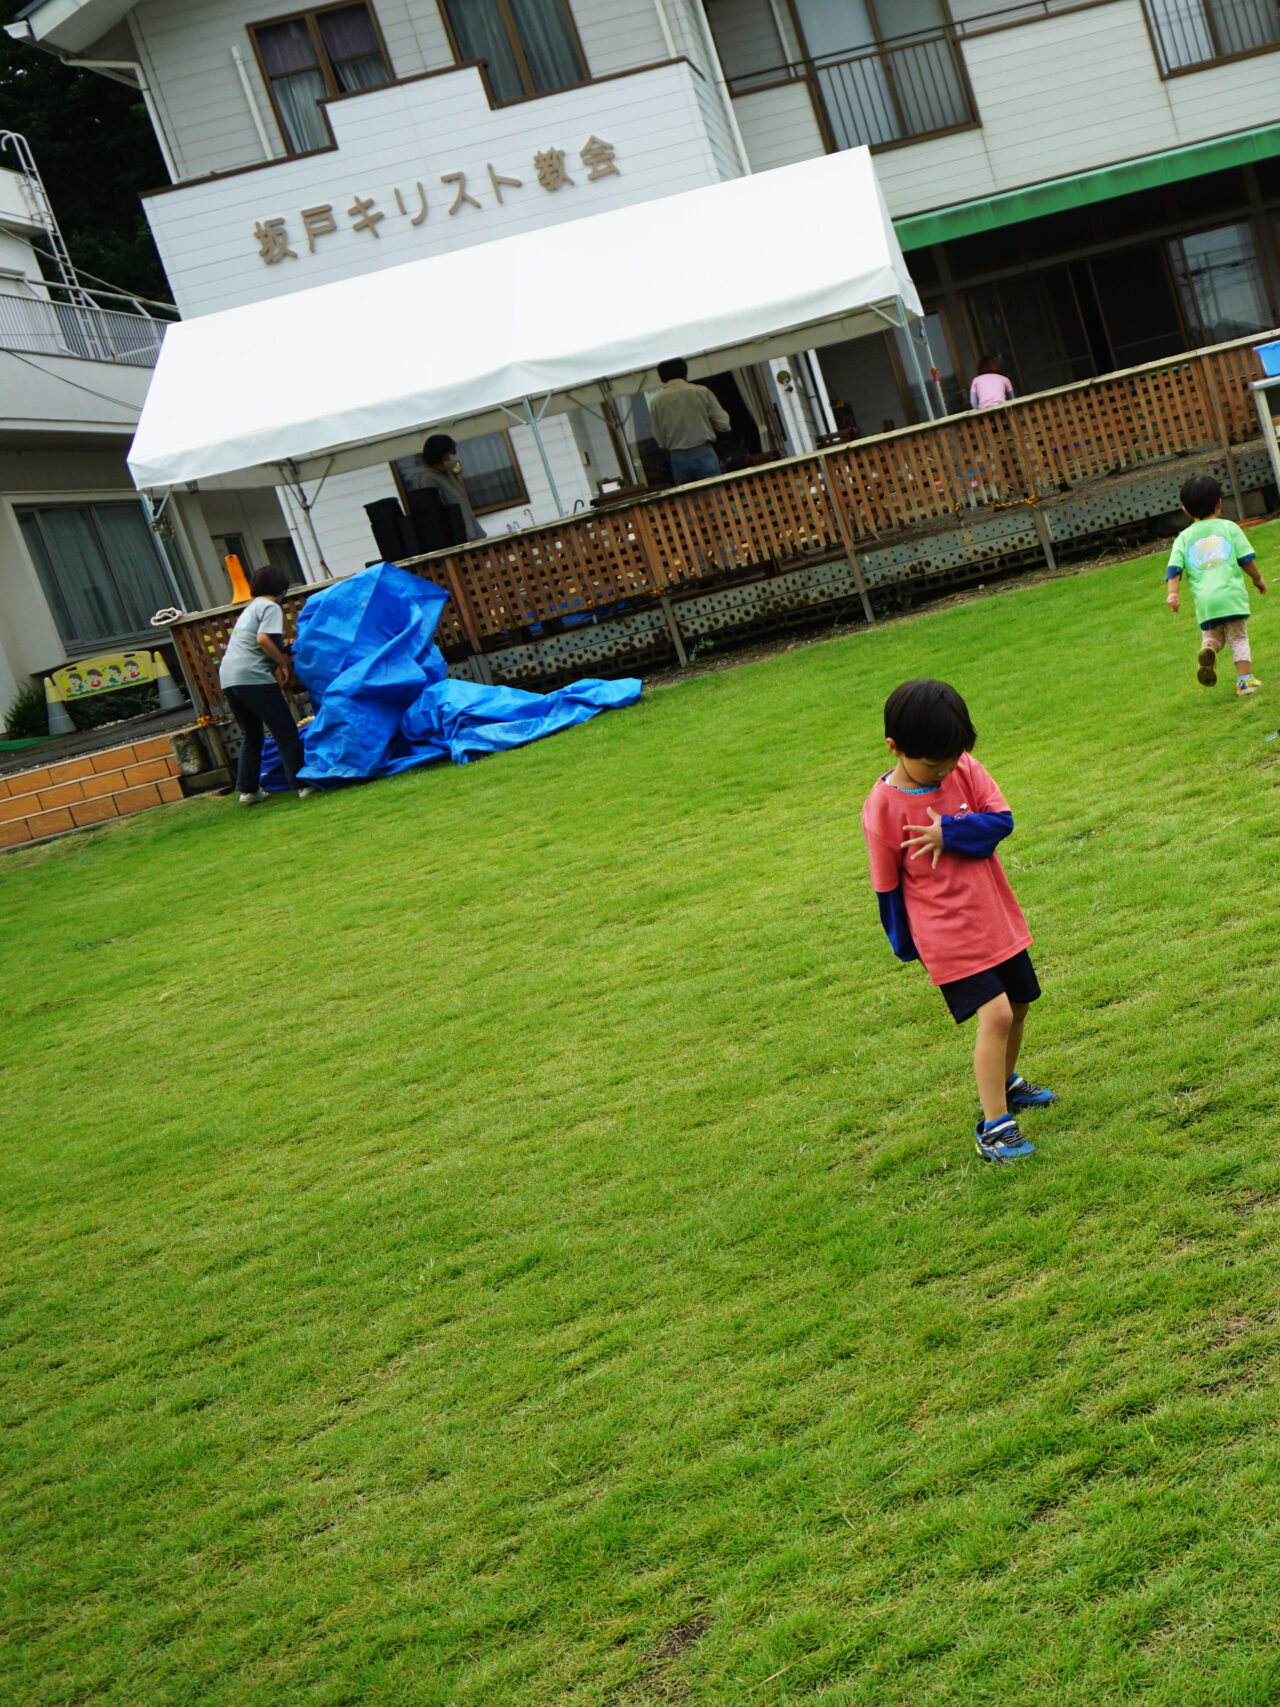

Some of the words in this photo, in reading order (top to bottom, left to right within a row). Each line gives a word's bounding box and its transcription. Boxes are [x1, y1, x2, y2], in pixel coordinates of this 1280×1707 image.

[254, 134, 621, 266] 坂戸キリスト教会
